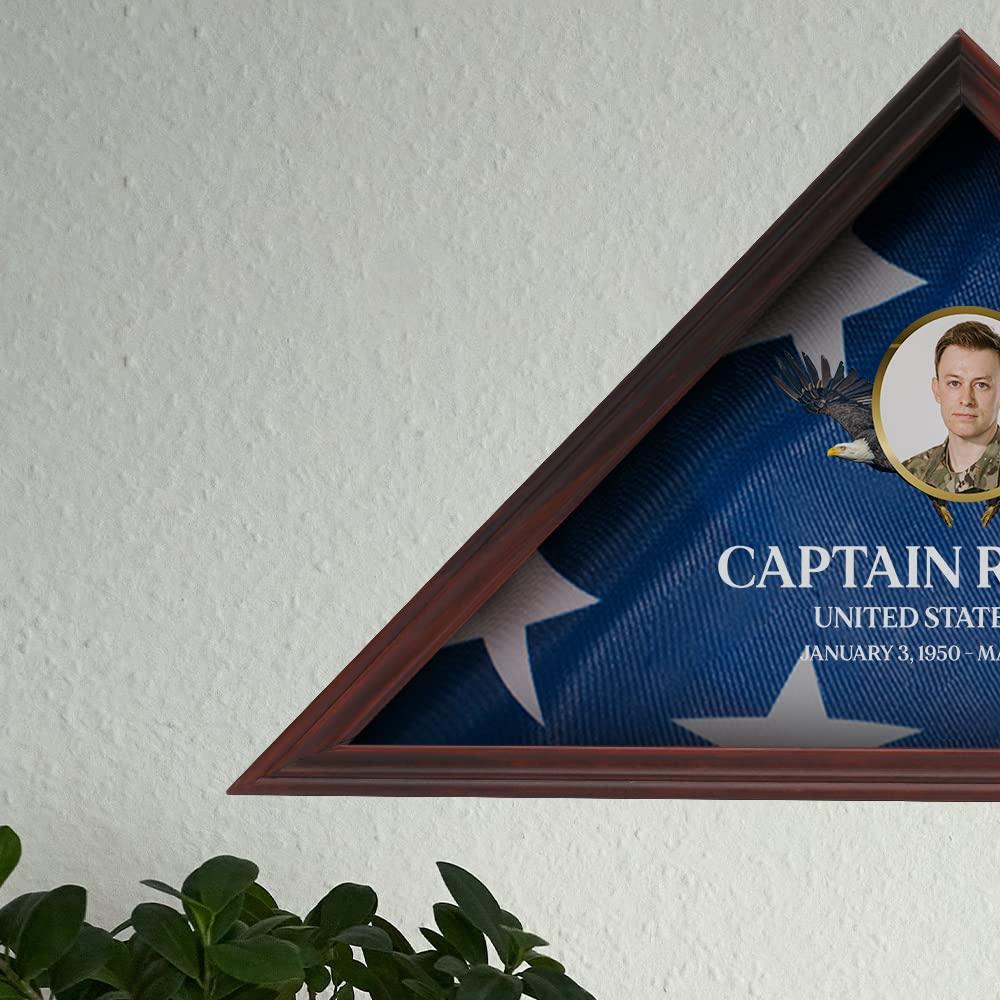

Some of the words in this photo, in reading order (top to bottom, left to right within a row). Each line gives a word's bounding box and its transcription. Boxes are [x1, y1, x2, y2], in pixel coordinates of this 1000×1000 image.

[717, 545, 962, 589] CAPTAIN
[814, 606, 919, 629] UNITED
[800, 644, 894, 662] JANUARY
[898, 645, 914, 664] 3,
[918, 645, 961, 662] 1950
